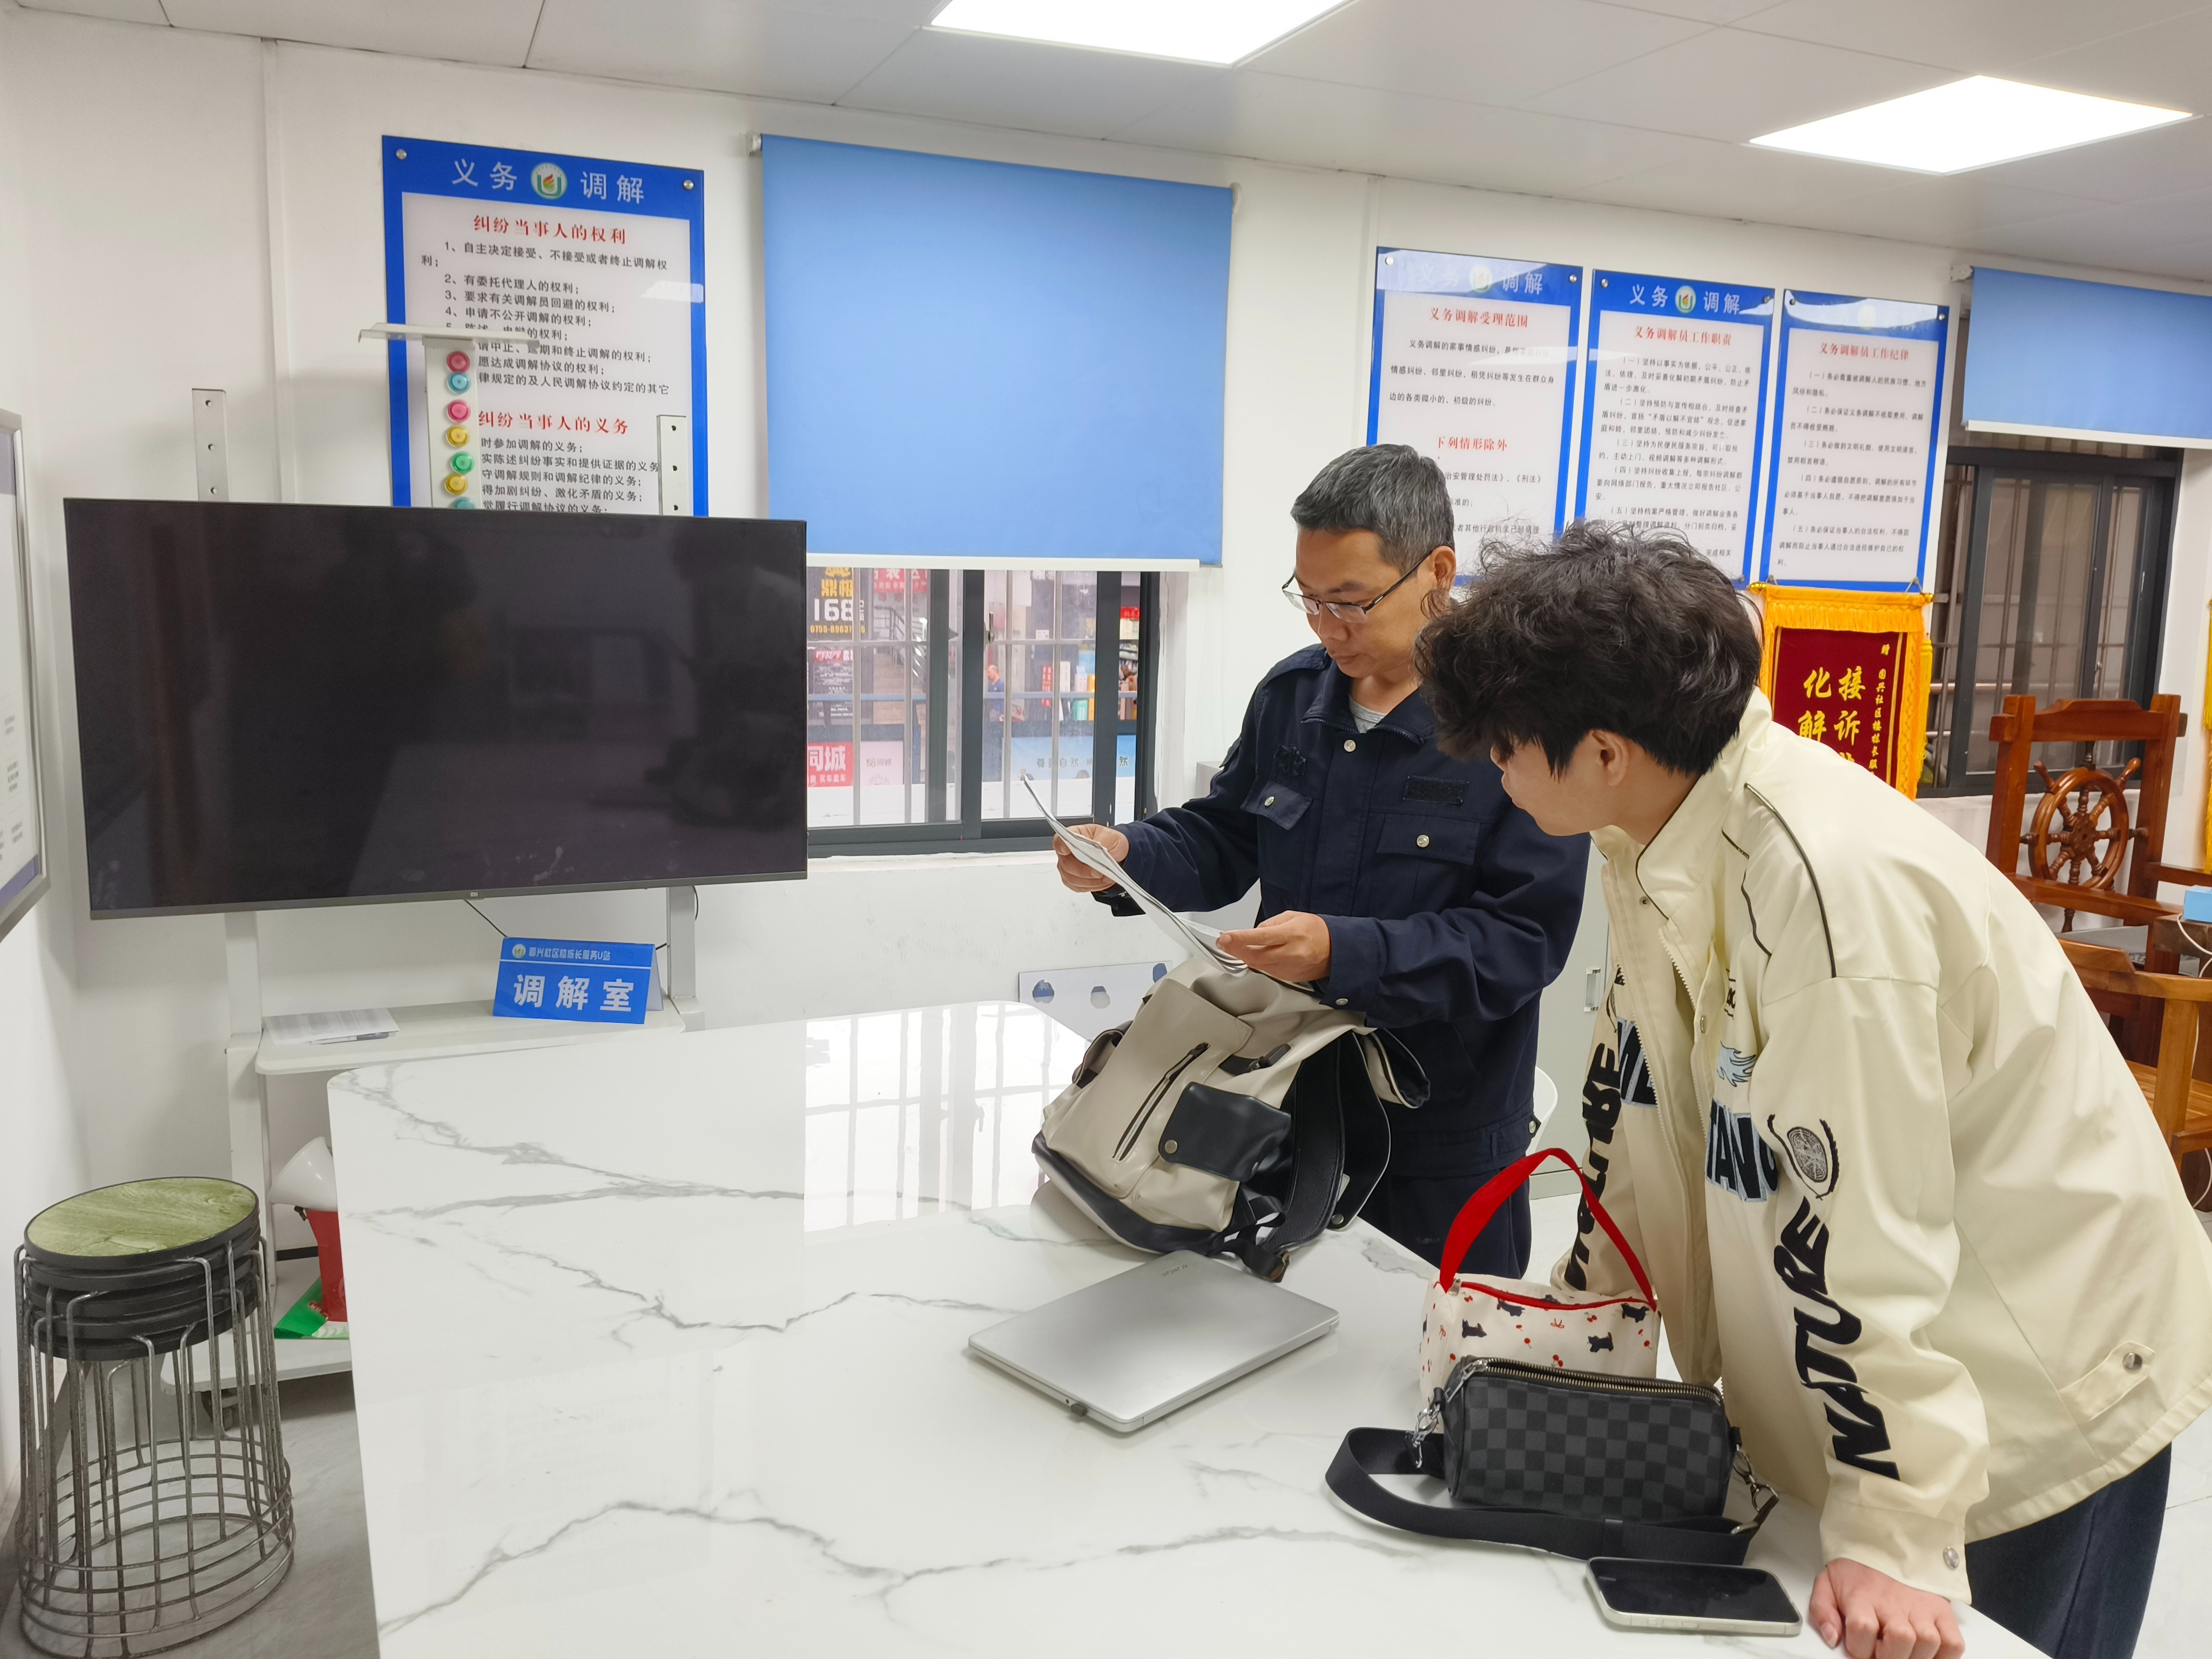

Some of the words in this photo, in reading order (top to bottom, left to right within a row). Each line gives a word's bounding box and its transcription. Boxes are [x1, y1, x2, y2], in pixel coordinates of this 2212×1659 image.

[452, 158, 517, 191] 义务
[580, 171, 644, 204] 调解
[474, 214, 626, 245] 纠纷当事人的权利
[444, 241, 667, 271] 1、自主决定接受、不接受或者终止调解权
[444, 274, 580, 294] 2、有委托代理人的权利；
[1501, 269, 1543, 295] 调解
[444, 291, 616, 314] 3、要求有关调解员回避的权利；
[1629, 284, 1668, 308] 义务
[1703, 291, 1741, 315] 调解
[444, 307, 592, 327] 4、申请不公开调解的权利；
[1429, 307, 1528, 328] 义务调解受理范围
[1634, 326, 1732, 346] 义务调解员工作职责
[478, 411, 629, 435] 纠纷当事人的义务
[1437, 436, 1507, 451] 下列情形除外
[513, 974, 634, 1012] 调解室
[1773, 1195, 1900, 1482] NATURE
